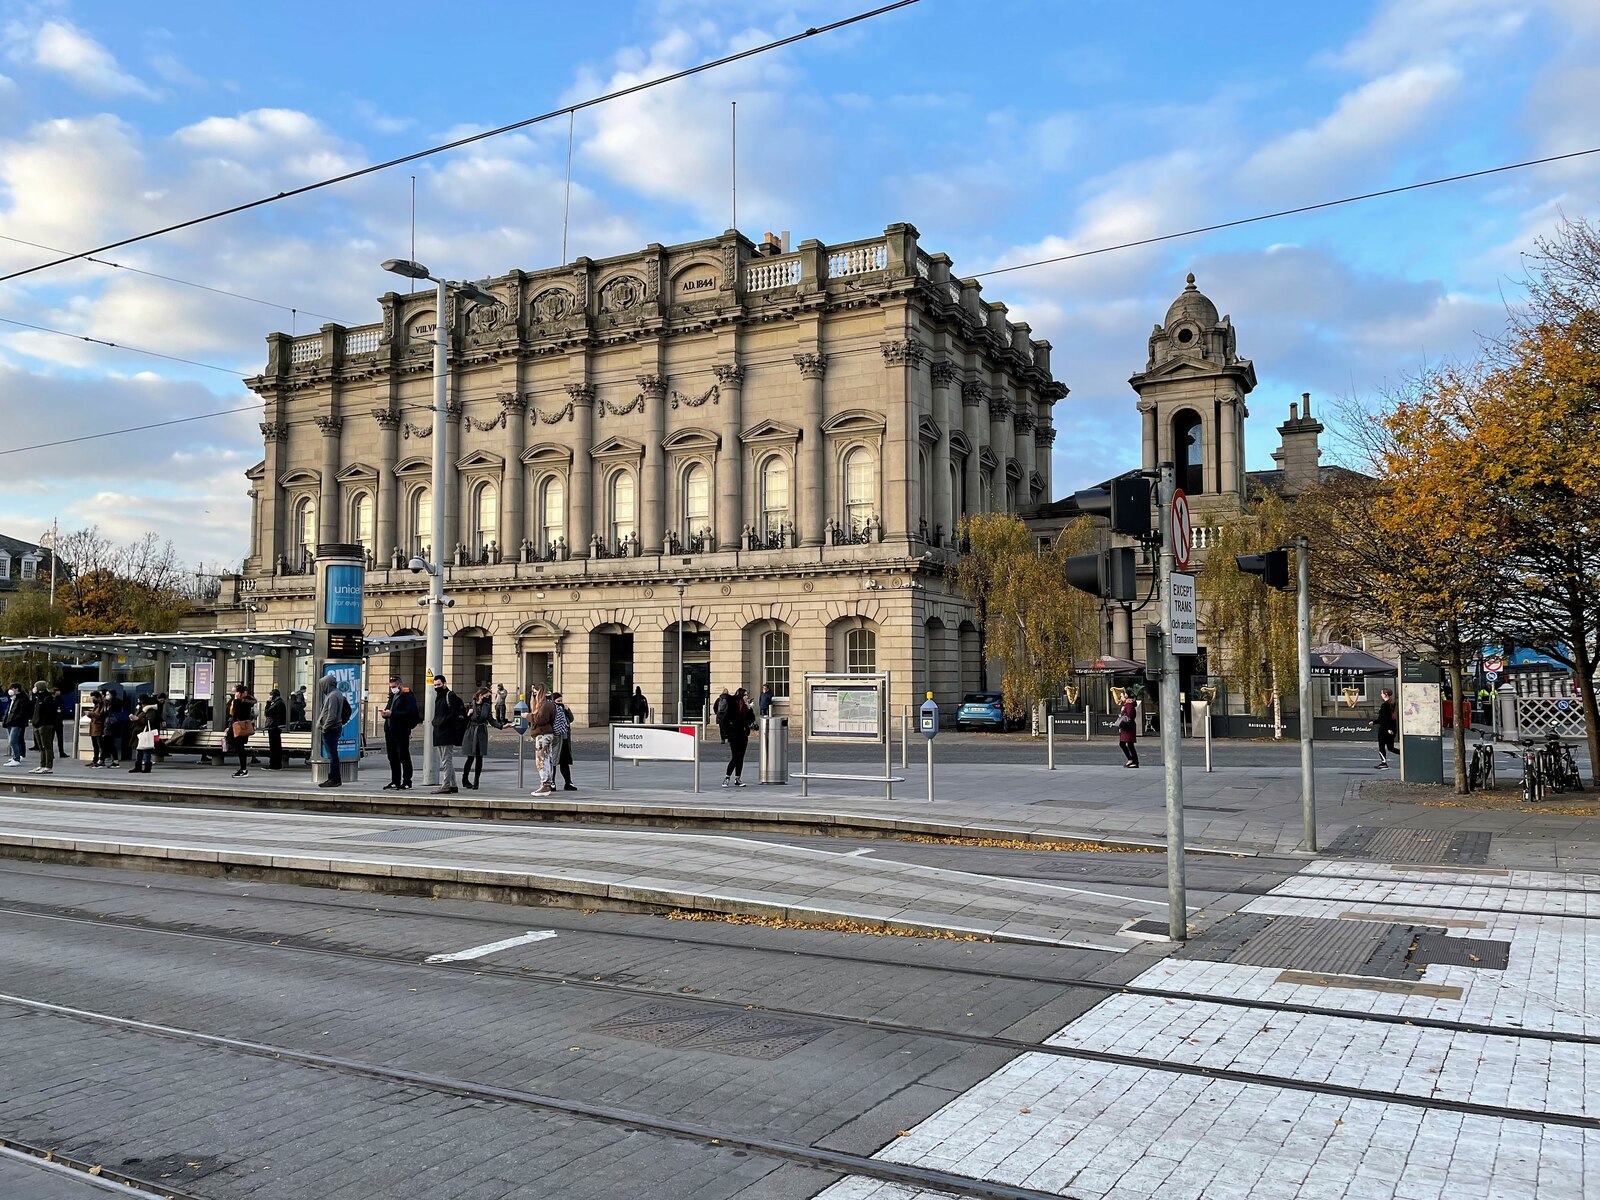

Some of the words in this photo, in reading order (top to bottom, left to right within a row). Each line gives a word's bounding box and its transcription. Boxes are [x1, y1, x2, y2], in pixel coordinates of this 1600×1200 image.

[696, 278, 713, 289] 1844
[1173, 584, 1192, 598] EXCEPT
[1174, 600, 1192, 613] TRAMS
